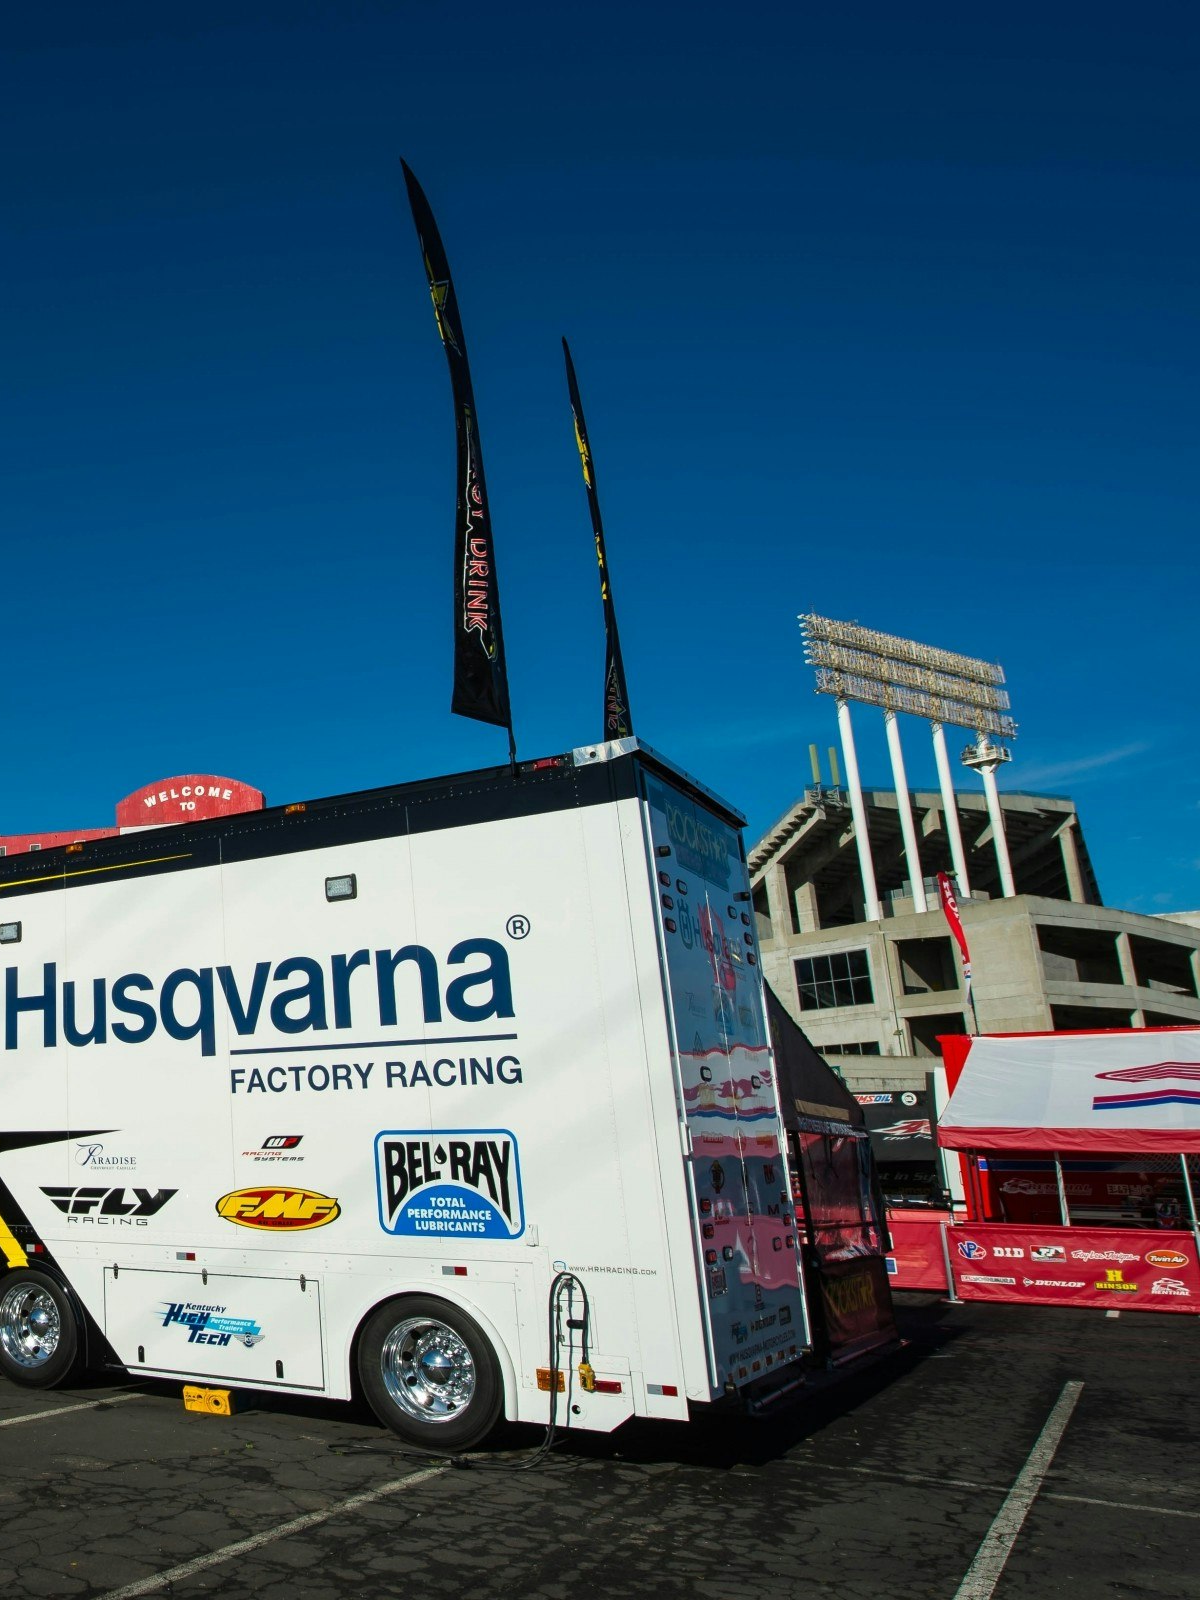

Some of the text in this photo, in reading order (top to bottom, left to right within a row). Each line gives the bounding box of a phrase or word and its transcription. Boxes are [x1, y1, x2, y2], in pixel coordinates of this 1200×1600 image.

[467, 536, 490, 632] DRINK
[144, 785, 233, 808] WELCOME
[180, 801, 196, 811] TO
[4, 937, 517, 1057] Husqvarna
[230, 1054, 523, 1094] FACTORY RACING
[266, 1137, 299, 1148] WP
[75, 1143, 137, 1166] PARADISE
[38, 1186, 180, 1217] FLY
[219, 1193, 338, 1219] FMF
[429, 1197, 466, 1208] TOTAL
[67, 1216, 148, 1226] RACING
[407, 1208, 492, 1221] PERFORMANCE
[415, 1220, 486, 1233] LUBRICANTS
[959, 1242, 977, 1258] VP
[1071, 1249, 1089, 1262] Troy
[1089, 1250, 1104, 1259] Lee
[1104, 1250, 1140, 1263] Designs
[1150, 1255, 1170, 1263] Twin
[1034, 1279, 1086, 1288] DUNLOP
[1096, 1282, 1138, 1291] HINSON
[1151, 1288, 1191, 1297] RENTHAL
[185, 1302, 227, 1313] Kentucky
[161, 1303, 211, 1327] HIGH
[210, 1317, 252, 1327] Performance
[188, 1324, 232, 1347] TECH
